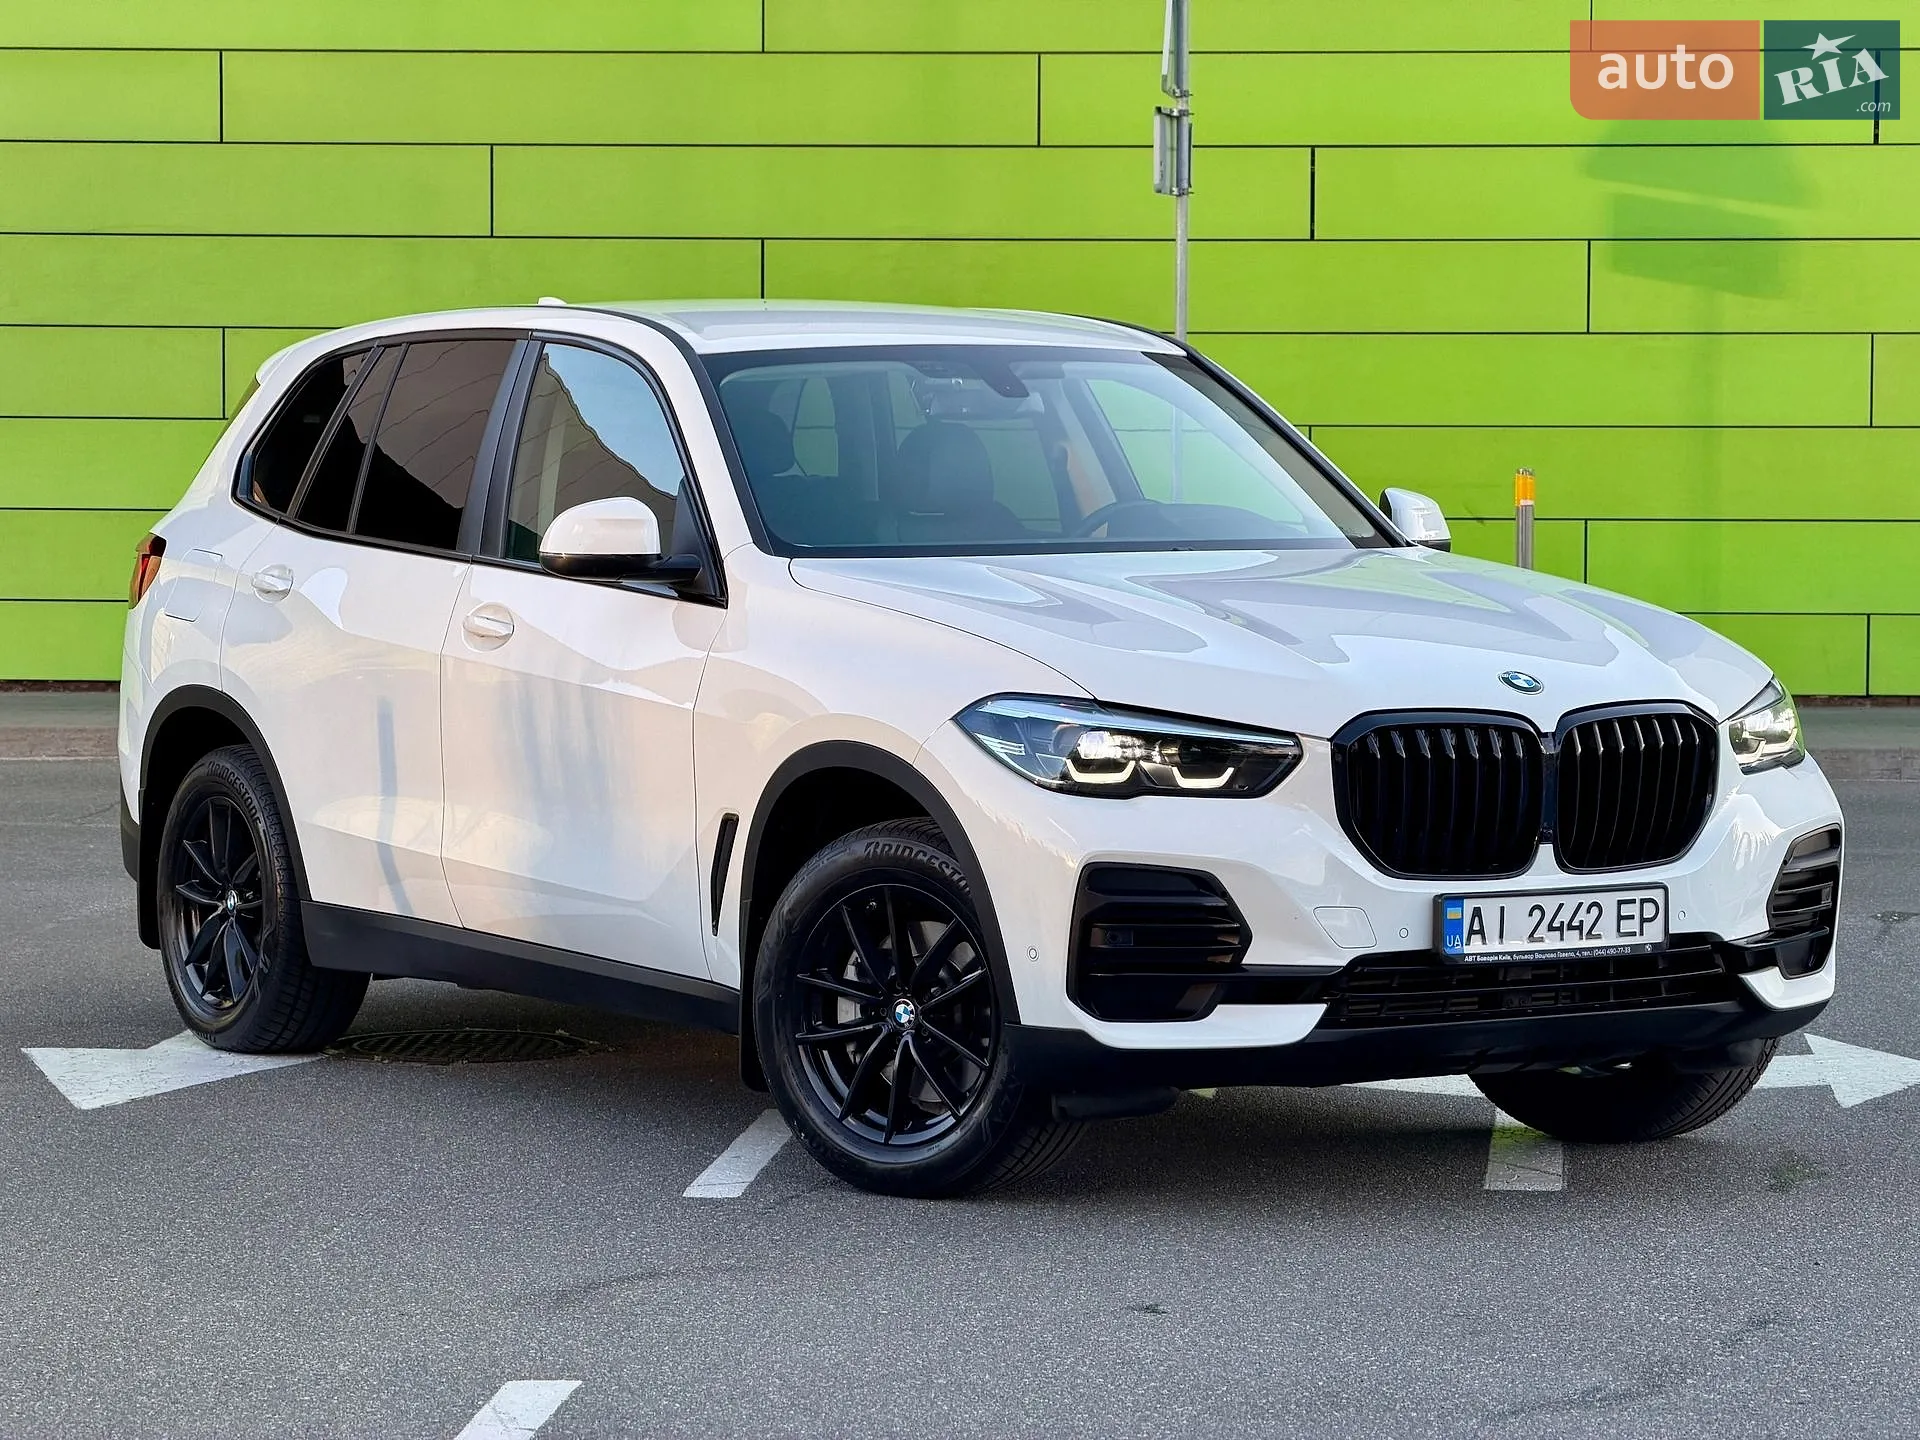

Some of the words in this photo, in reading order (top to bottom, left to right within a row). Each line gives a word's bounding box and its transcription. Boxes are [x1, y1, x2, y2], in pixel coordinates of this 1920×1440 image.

[1465, 905, 1504, 946] AI
[1527, 901, 1603, 943] 2442
[1616, 897, 1660, 938] EP
[1446, 935, 1462, 949] UA
